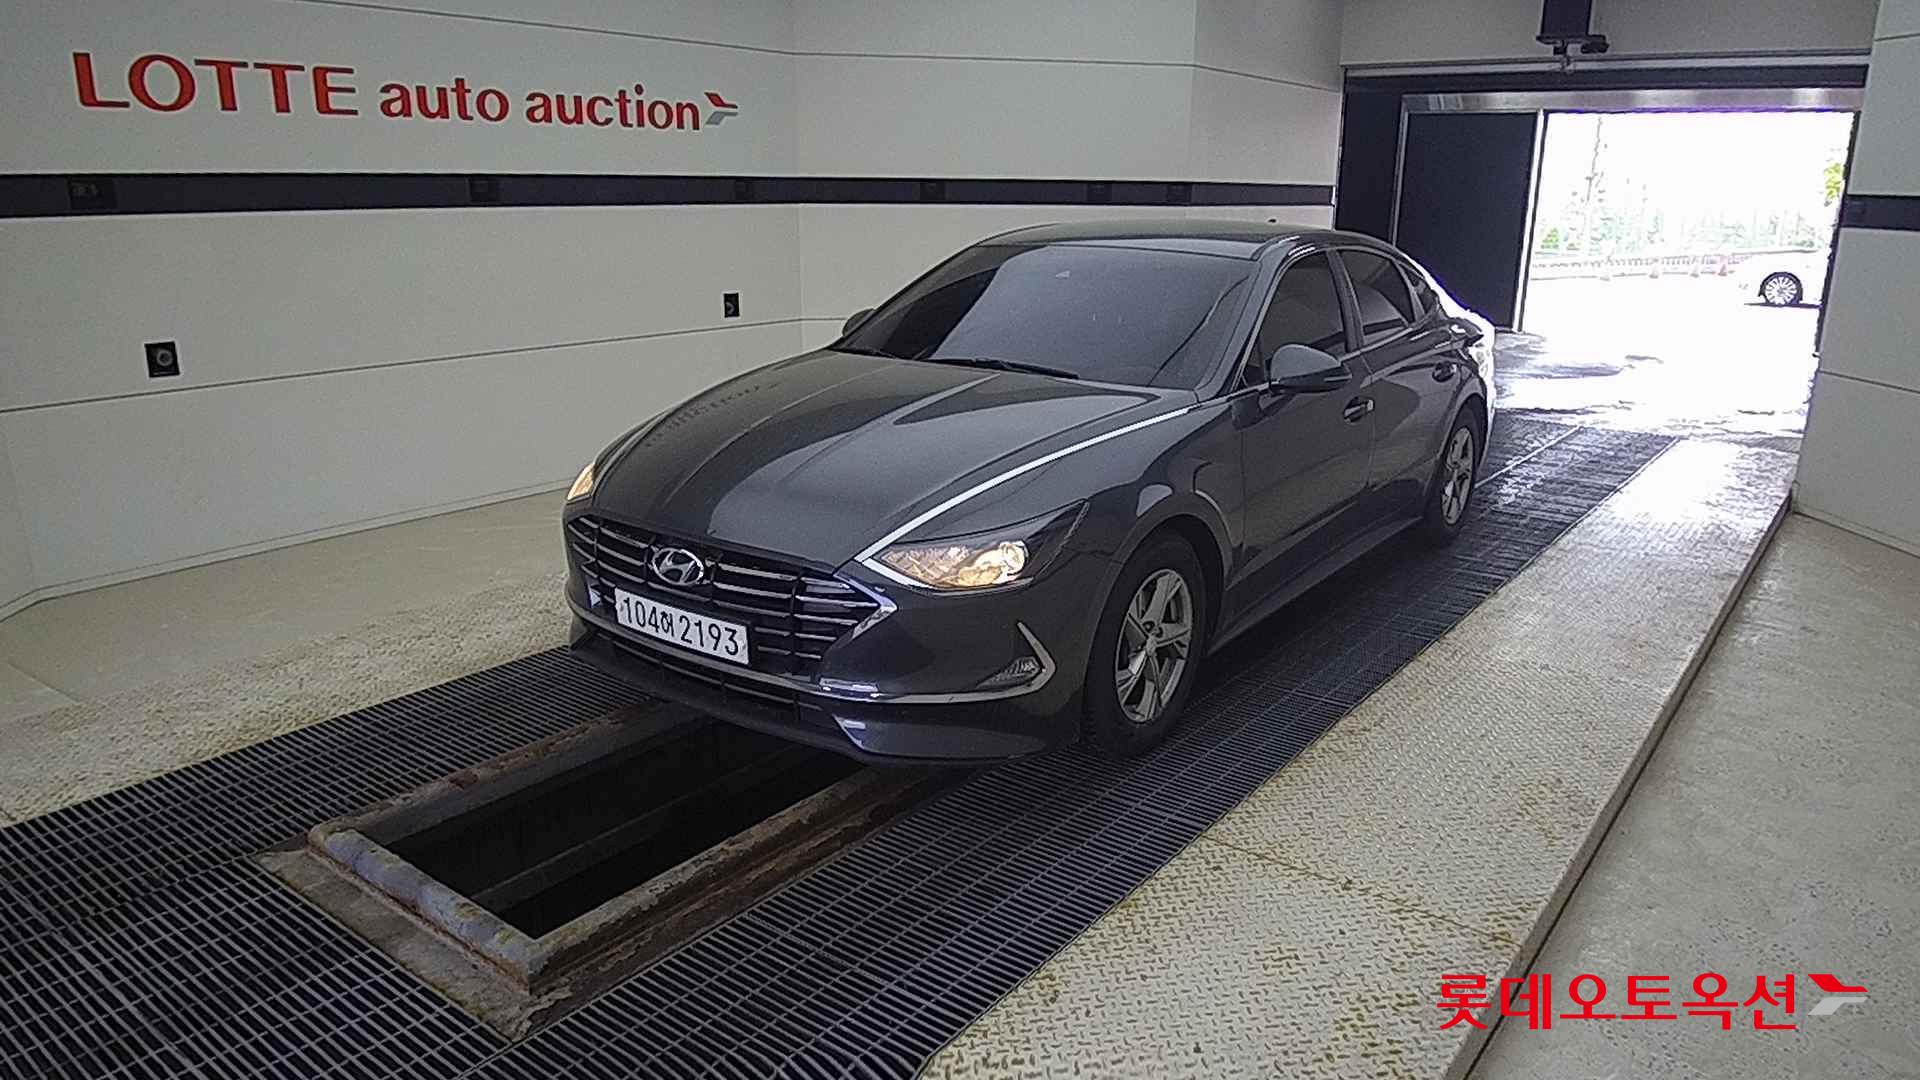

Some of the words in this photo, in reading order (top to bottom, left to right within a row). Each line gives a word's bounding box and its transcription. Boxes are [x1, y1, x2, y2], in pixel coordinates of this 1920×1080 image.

[73, 52, 359, 116] LOTTE
[379, 78, 510, 123] auto
[525, 85, 701, 131] auction
